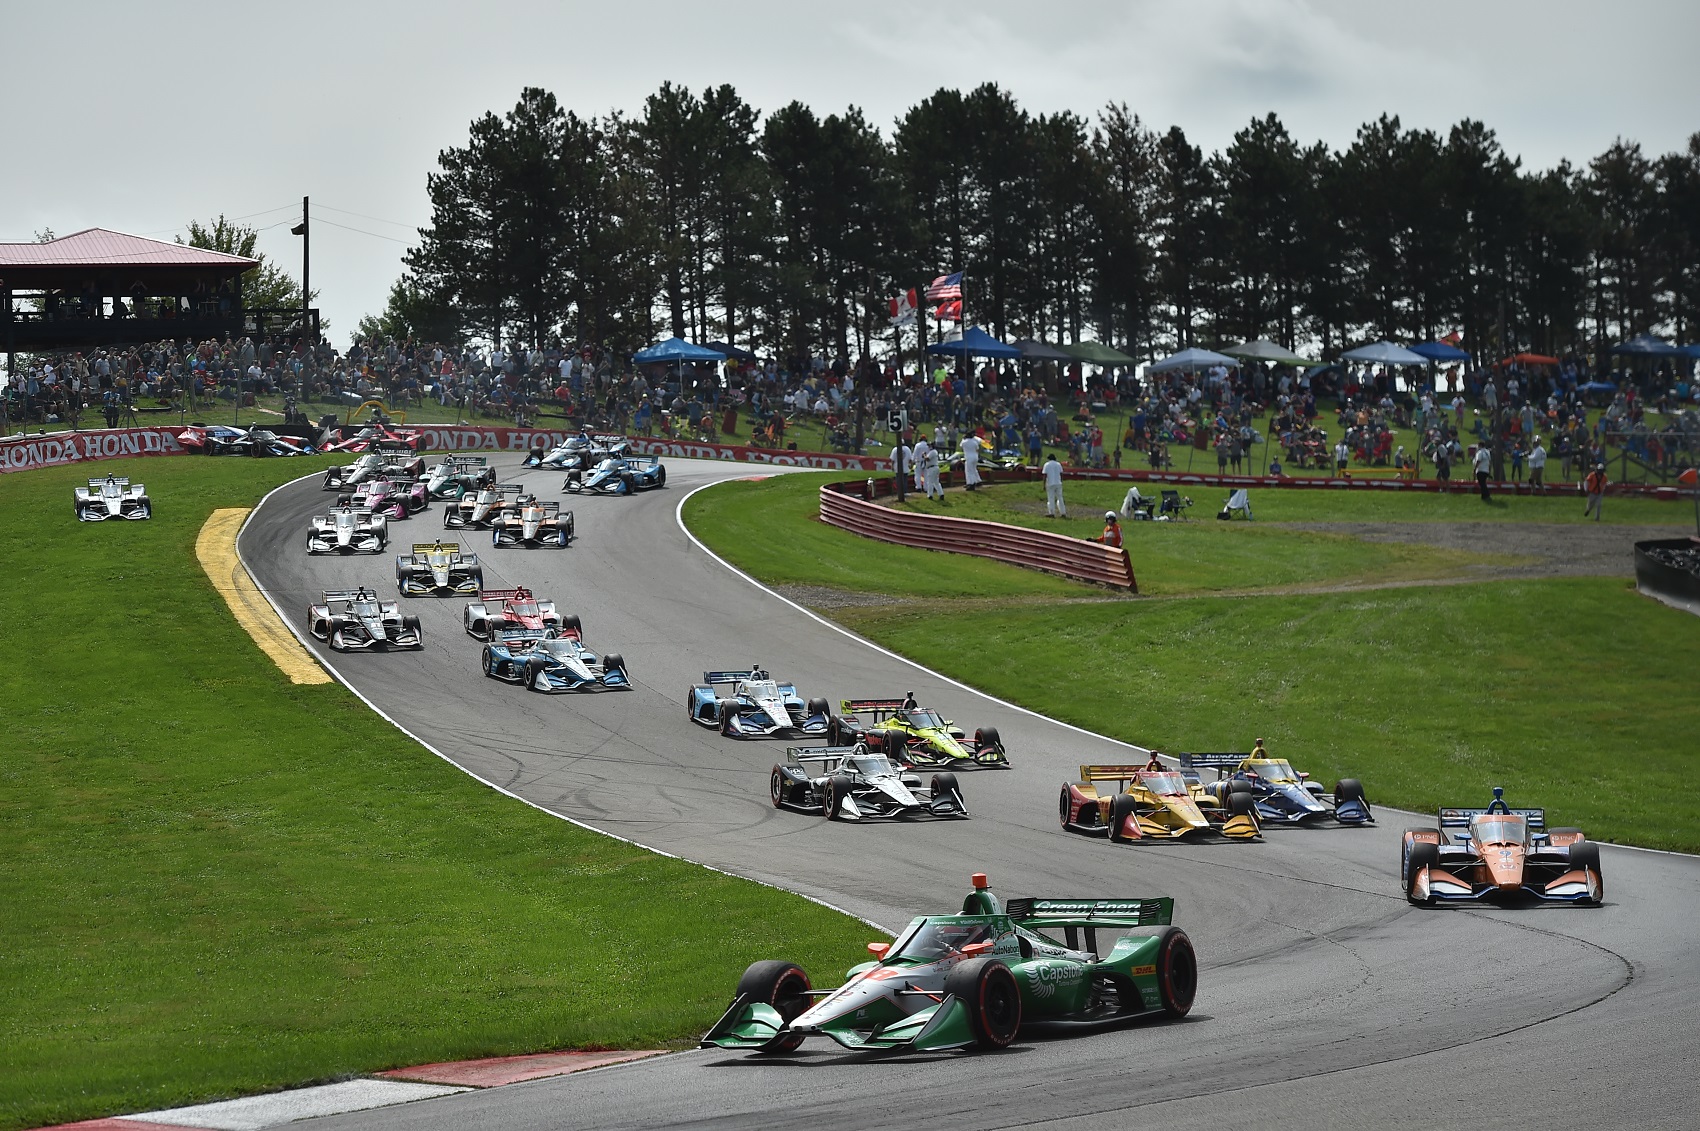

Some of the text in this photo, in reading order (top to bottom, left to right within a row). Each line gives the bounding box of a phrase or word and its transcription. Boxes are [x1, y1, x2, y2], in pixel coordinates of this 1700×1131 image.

[889, 411, 902, 431] 5
[0, 431, 184, 469] HONDA HONDA
[422, 430, 500, 451] ONDA
[627, 438, 736, 461] HONDA
[746, 452, 863, 471] HONDA
[1034, 900, 1088, 914] Green
[1040, 965, 1084, 984] Capstone
[1135, 966, 1154, 975] DHL
